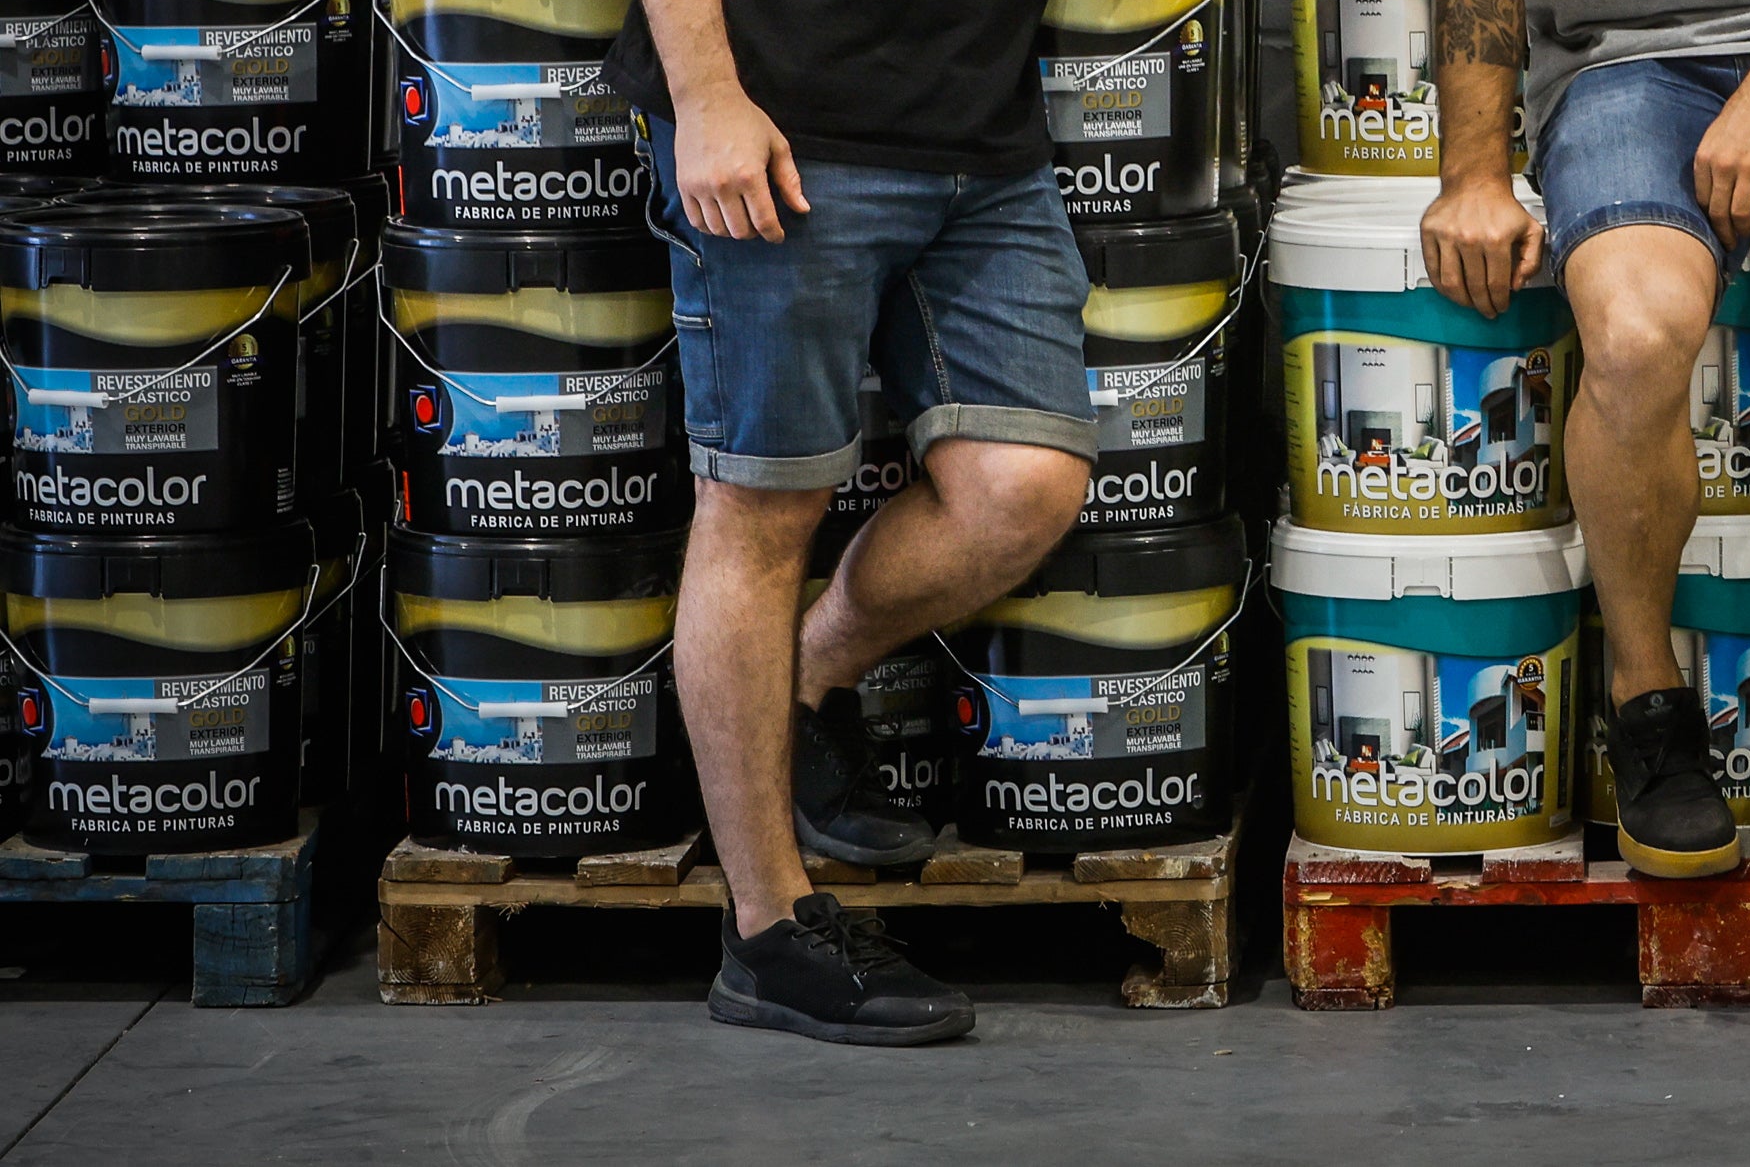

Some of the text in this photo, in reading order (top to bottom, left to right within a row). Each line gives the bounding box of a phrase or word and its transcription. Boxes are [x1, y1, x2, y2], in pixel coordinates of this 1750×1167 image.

[206, 29, 311, 45] REVESTIMIENTO
[232, 60, 289, 74] GOLD
[1055, 59, 1165, 78] REVESTIMIENTO
[233, 76, 288, 85] EXTERIOR
[233, 86, 251, 94] MUY
[1082, 92, 1142, 109] GOLD
[1084, 110, 1142, 121] EXTERIOR
[0, 106, 95, 145] color
[1084, 121, 1141, 130] MUY LAVABLE
[118, 117, 306, 156] metacolor
[7, 148, 72, 162] PINTURAS
[1344, 145, 1433, 159] FÁBRICA DE
[133, 160, 278, 173] FABRICA DE PINTURAS
[1054, 154, 1160, 195] color
[432, 159, 644, 201] metacolor
[456, 205, 618, 220] FABRICA DE PINTURAS
[97, 373, 210, 391] REVESTIMIENTO
[566, 372, 662, 392] REVESTIMIENTO
[1104, 365, 1201, 387] REVESTIMIENTO
[125, 406, 186, 421] GOLD
[593, 407, 644, 422] GOLD
[1131, 398, 1183, 417] GOLD
[126, 424, 185, 434] EXTERIOR
[1132, 416, 1183, 429] EXTERIOR
[148, 434, 186, 442] LAVABLE
[1131, 427, 1183, 439] MUY LAVABLE
[126, 441, 186, 450] TRANSPIRABLE
[1086, 461, 1197, 504] color
[1317, 450, 1549, 500] metacolor
[17, 466, 206, 506] metacolor
[446, 467, 657, 510] metacolor
[1705, 486, 1725, 498] DE
[30, 509, 175, 525] FABRICA DE PINTURAS
[1080, 506, 1174, 523] DE PINTURAS
[1344, 501, 1524, 519] FÁBRICA DE PINTURAS
[471, 512, 634, 528] FABRICA DE PINTURAS
[162, 678, 265, 697] REVESTIMIENTO
[550, 680, 652, 700] REVESTIMIENTO
[1099, 672, 1200, 695] REVESTIMIENTO
[190, 709, 244, 726] GOLD
[576, 714, 632, 731] GOLD
[1126, 706, 1181, 724] GOLD
[190, 727, 244, 740] EXTERIOR
[577, 731, 631, 743] EXTERIOR
[1127, 724, 1181, 737] EXTERIOR
[190, 737, 244, 749] MUY LAVABLE
[576, 741, 631, 752] MUY LAVABLE
[1127, 734, 1181, 746] MUY LAVABLE
[1127, 742, 1182, 753] TRANSPIRABLE
[576, 749, 631, 759] TRANSPIRABLE
[1313, 757, 1544, 807] metacolor
[49, 771, 260, 814] metacolor
[436, 775, 646, 816] metacolor
[986, 768, 1198, 813] metacolor
[72, 815, 234, 832] FABRICA DE PINTURAS
[1009, 813, 1172, 830] FABRICA DE PINTURAS
[1336, 807, 1515, 825] FÁBRICA DE PINTURAS
[457, 820, 620, 835] FABRICA DE PINTURAS
